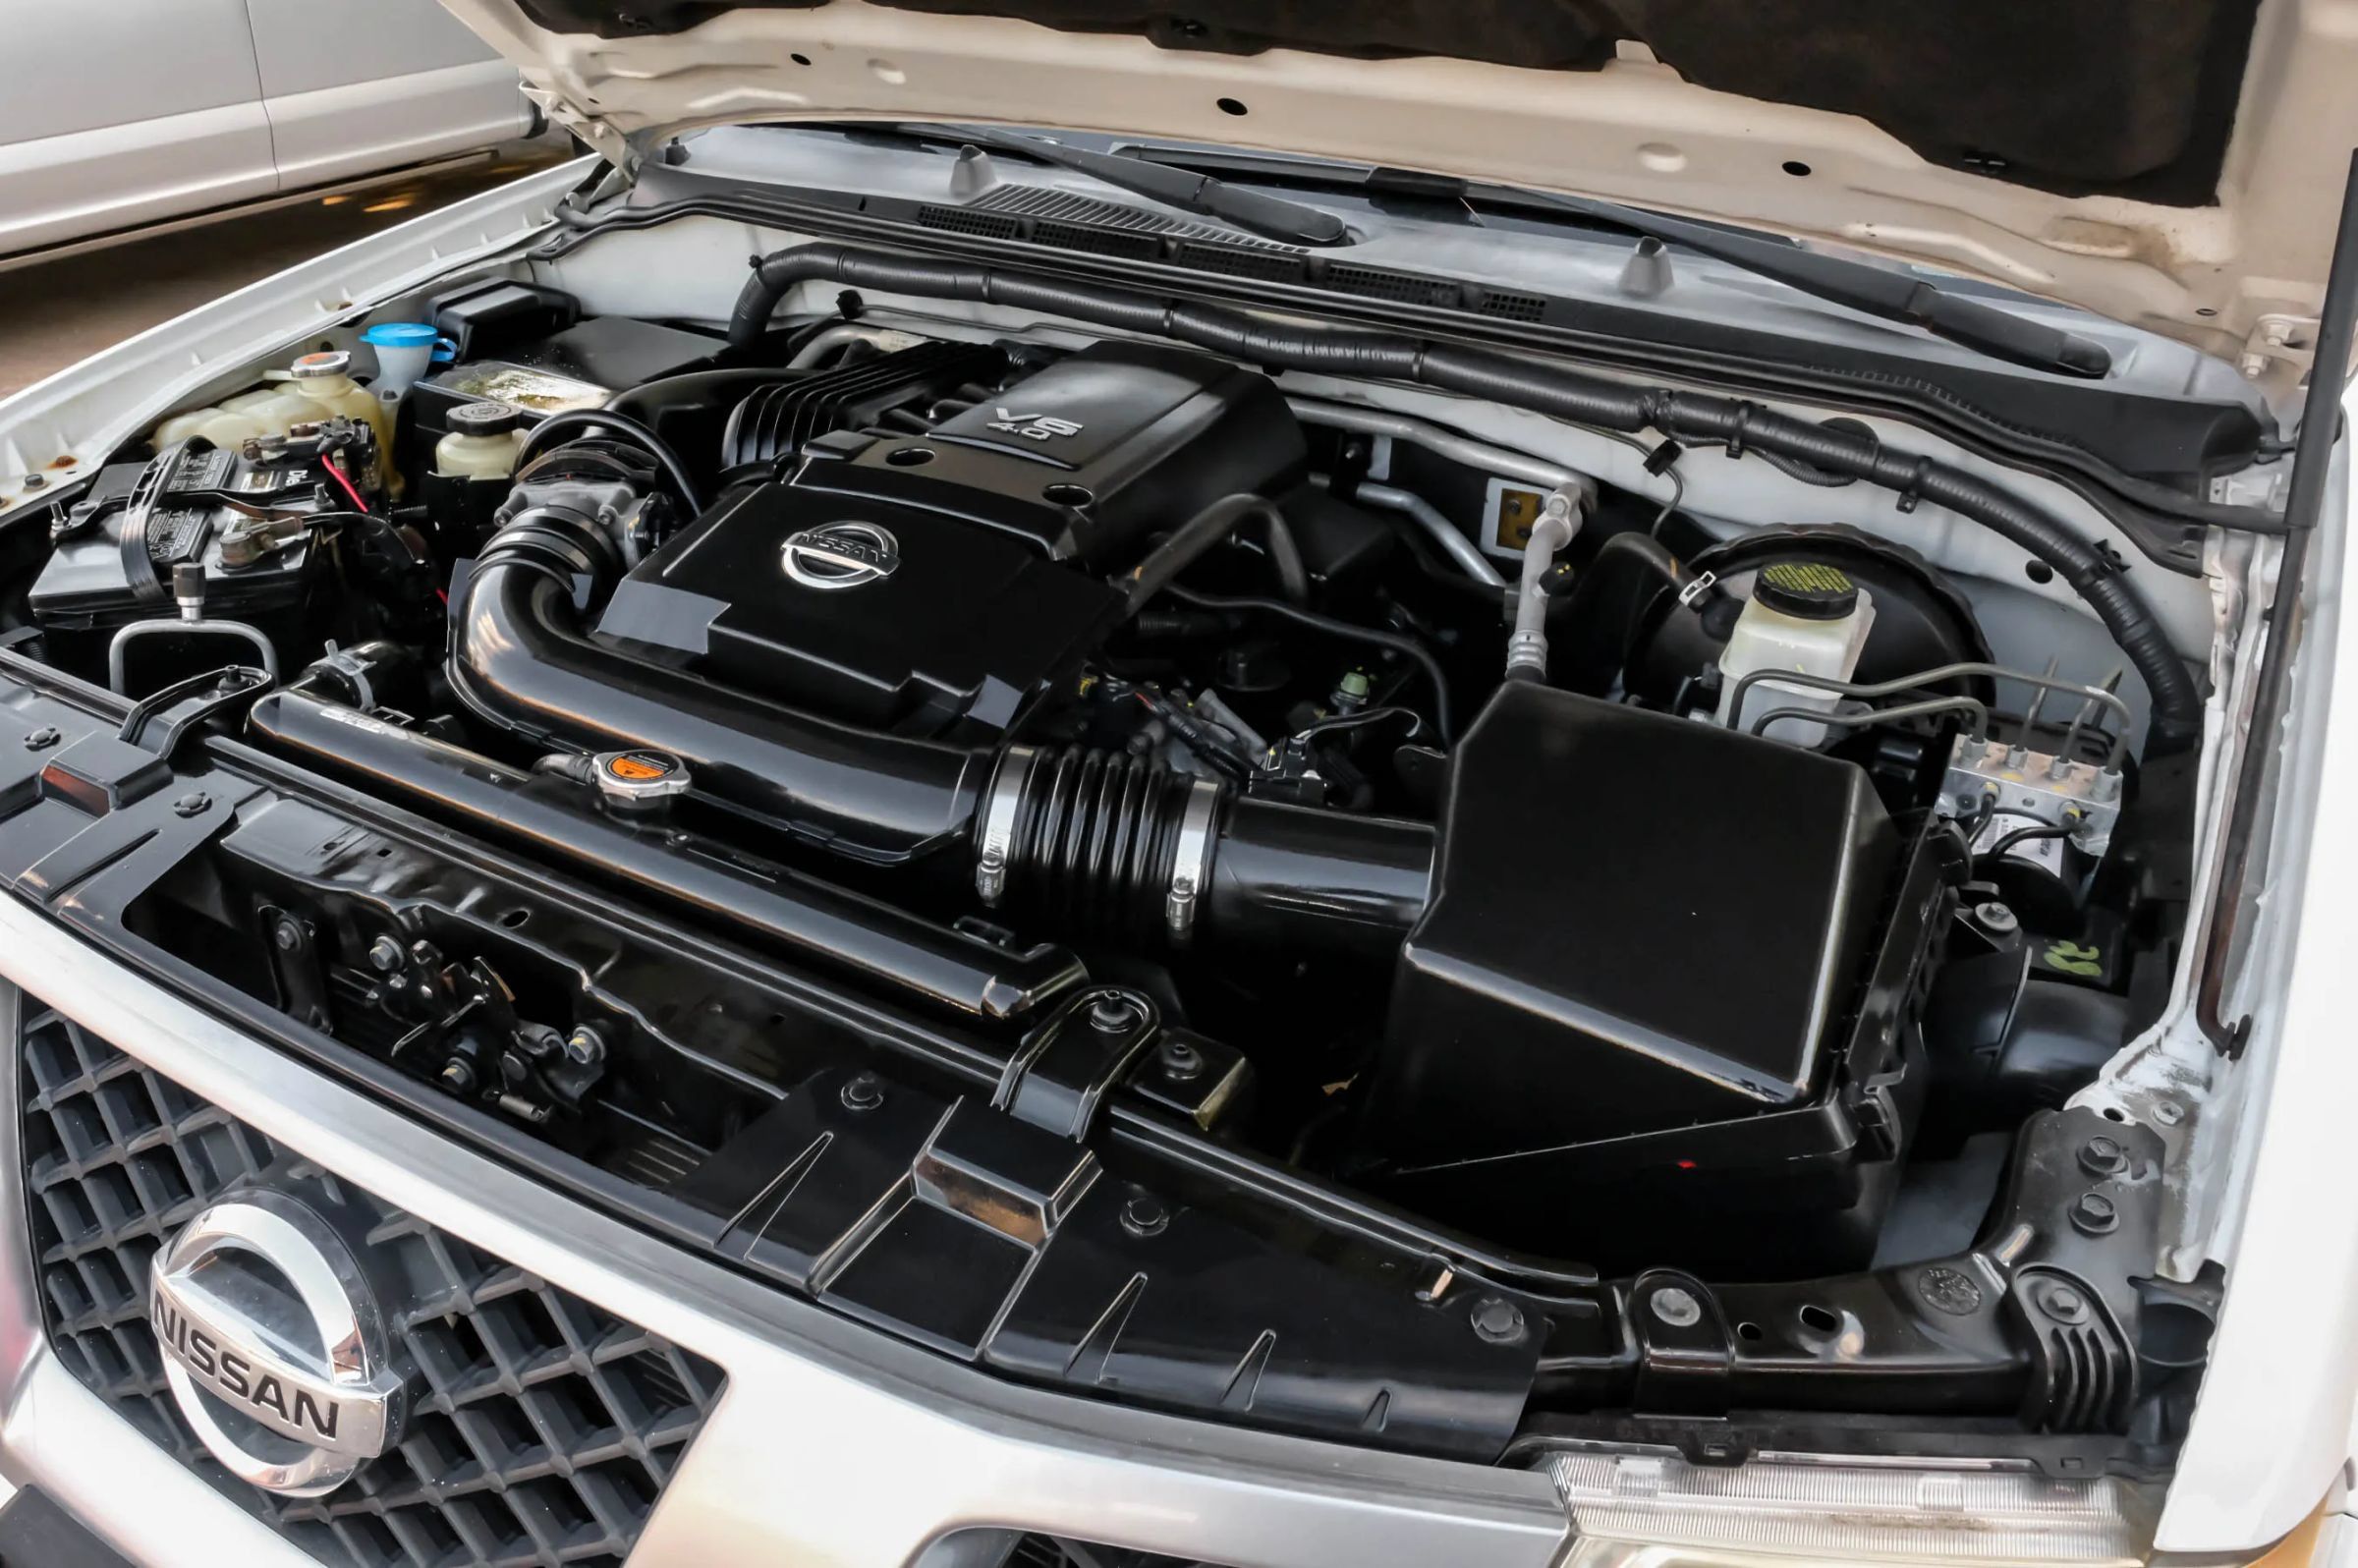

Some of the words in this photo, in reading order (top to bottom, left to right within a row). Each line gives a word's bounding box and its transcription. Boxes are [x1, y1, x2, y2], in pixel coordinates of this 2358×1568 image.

[986, 422, 1051, 440] 4.0
[995, 407, 1084, 437] V6
[797, 533, 887, 563] NISSAN
[152, 1288, 340, 1441] NISSAN
